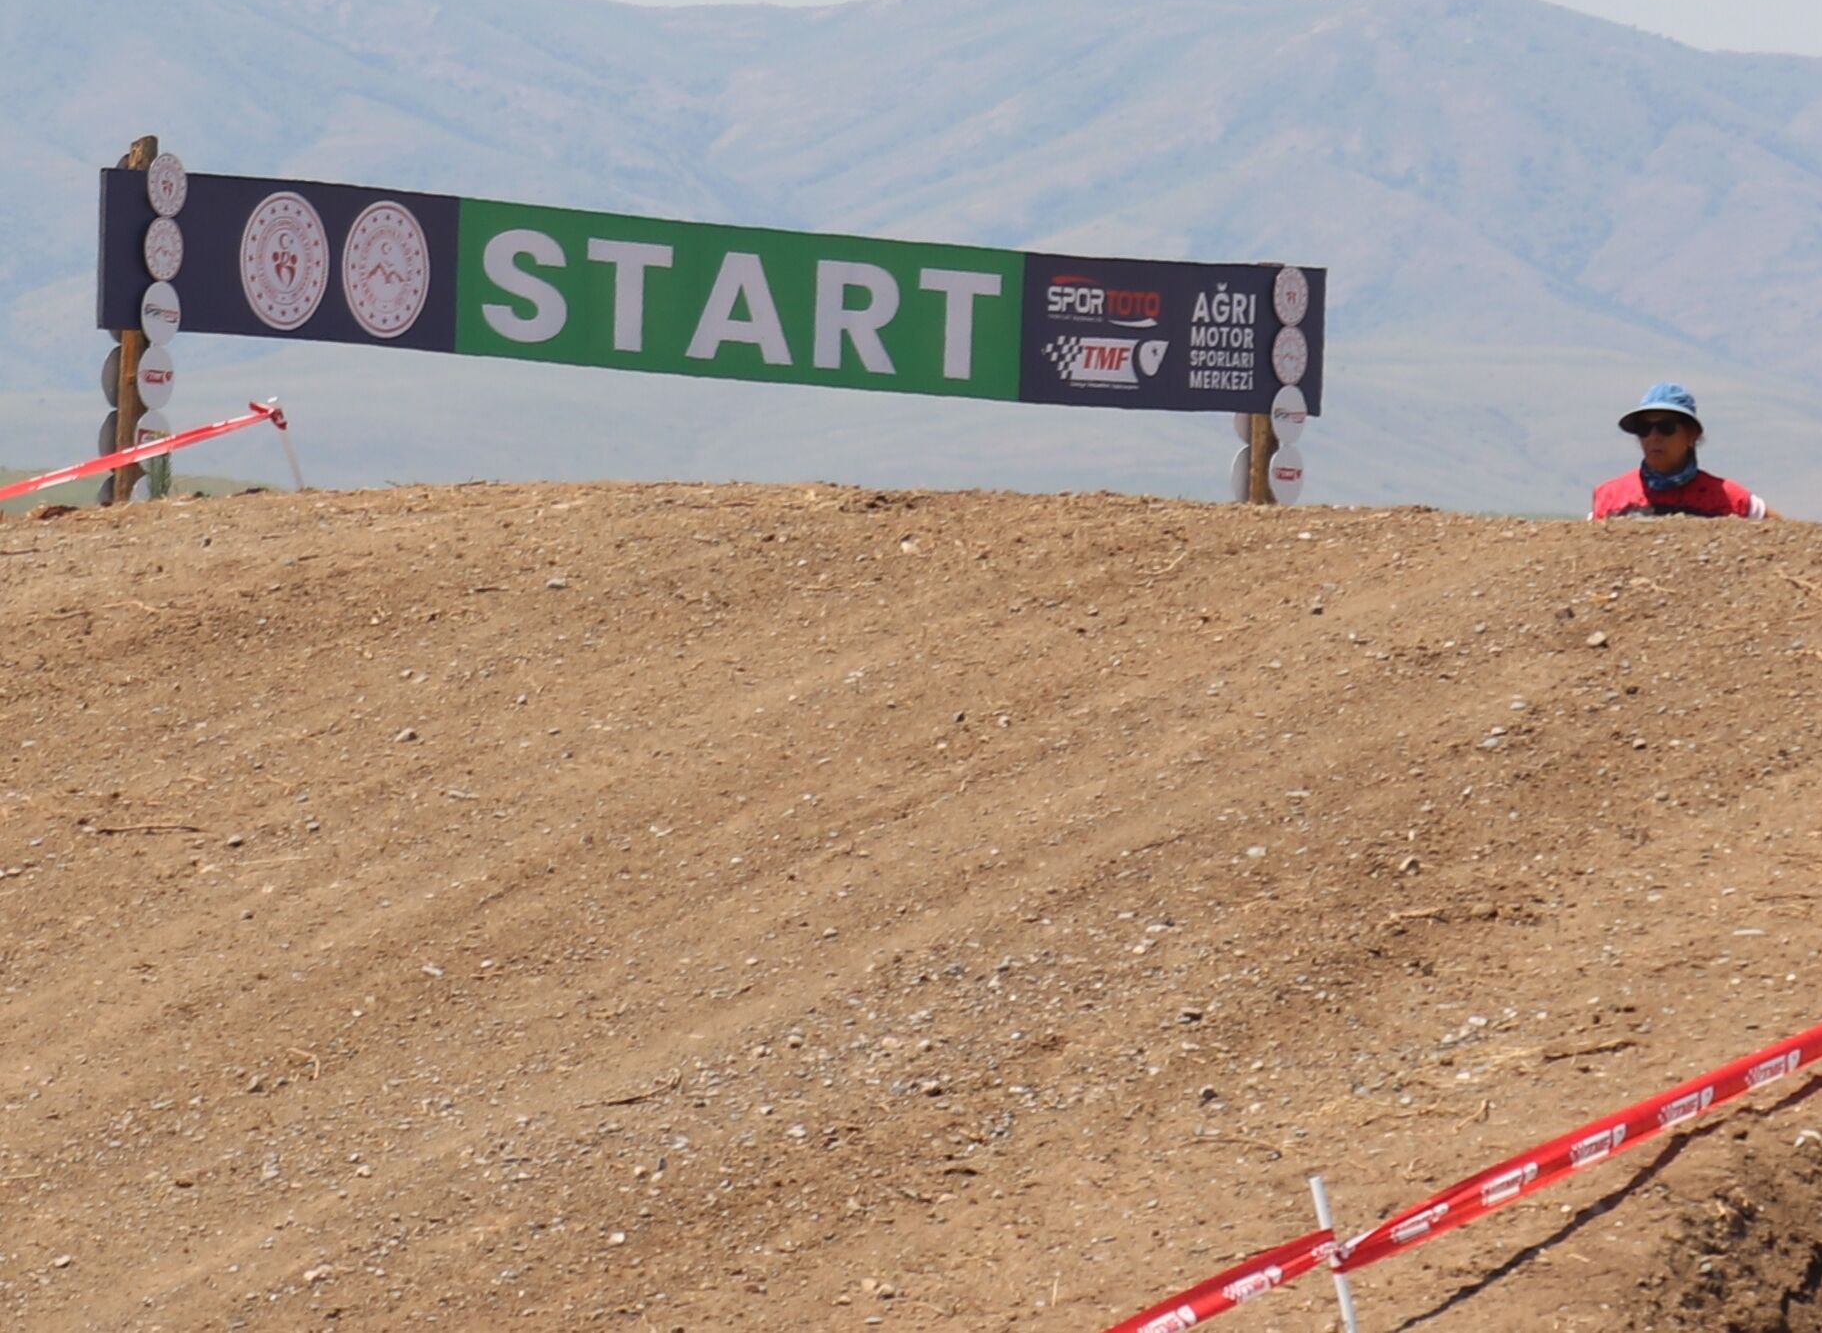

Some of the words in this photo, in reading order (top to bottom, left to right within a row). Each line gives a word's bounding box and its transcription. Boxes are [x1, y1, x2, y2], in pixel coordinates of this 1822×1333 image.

[481, 228, 1002, 380] START
[1191, 282, 1256, 325] AĞRI
[1190, 326, 1255, 349] MOTOR
[1082, 345, 1132, 371] TMF
[1189, 349, 1255, 368] SPORLARI
[1189, 370, 1254, 390] MERKEZİ
